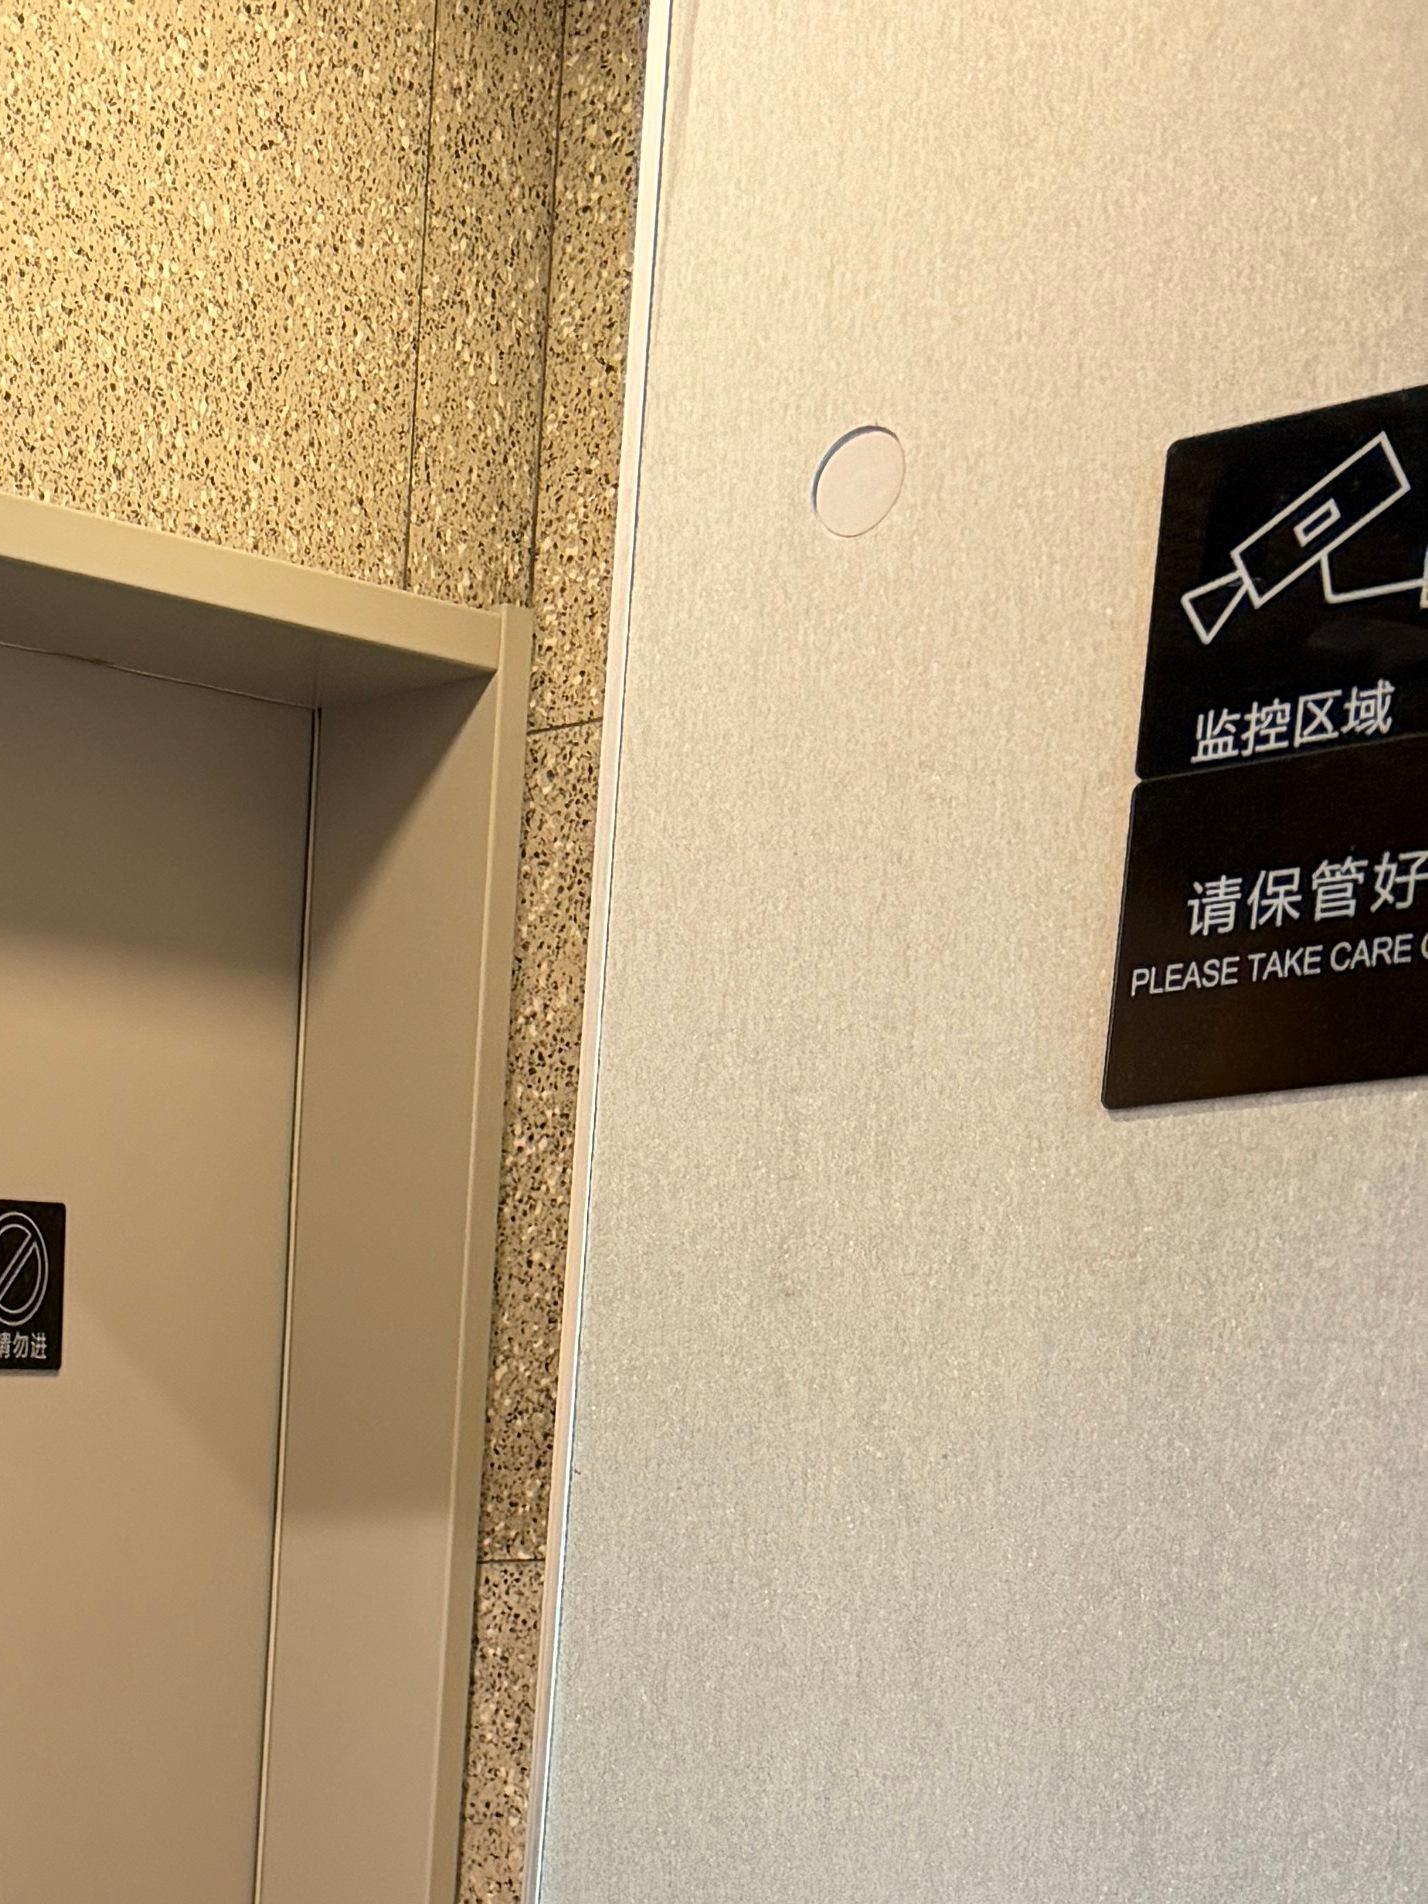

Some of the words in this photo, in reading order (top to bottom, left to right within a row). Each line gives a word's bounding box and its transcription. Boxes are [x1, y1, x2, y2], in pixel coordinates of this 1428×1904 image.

[1191, 678, 1395, 763] 监控区域
[1187, 850, 1428, 937] 请保管好
[1131, 955, 1240, 997] PLEASE
[1248, 944, 1324, 982] TAKE
[1330, 933, 1415, 972] CARE
